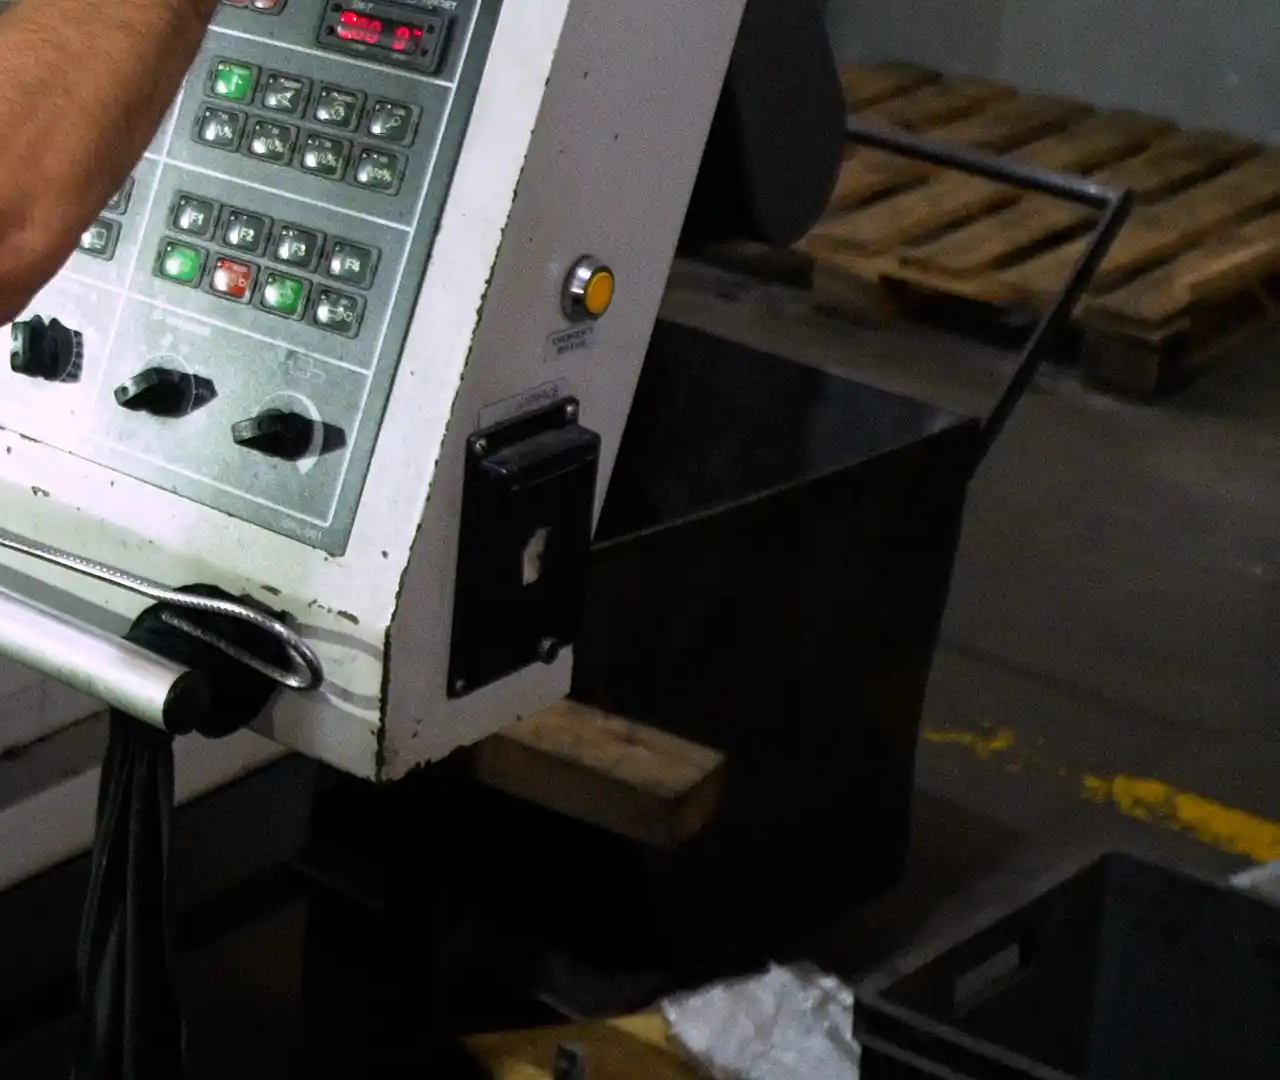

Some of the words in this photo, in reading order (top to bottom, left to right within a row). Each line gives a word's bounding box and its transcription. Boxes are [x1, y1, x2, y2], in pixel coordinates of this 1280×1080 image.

[190, 212, 204, 226] F1
[240, 226, 254, 242] F2
[291, 242, 306, 256] F3
